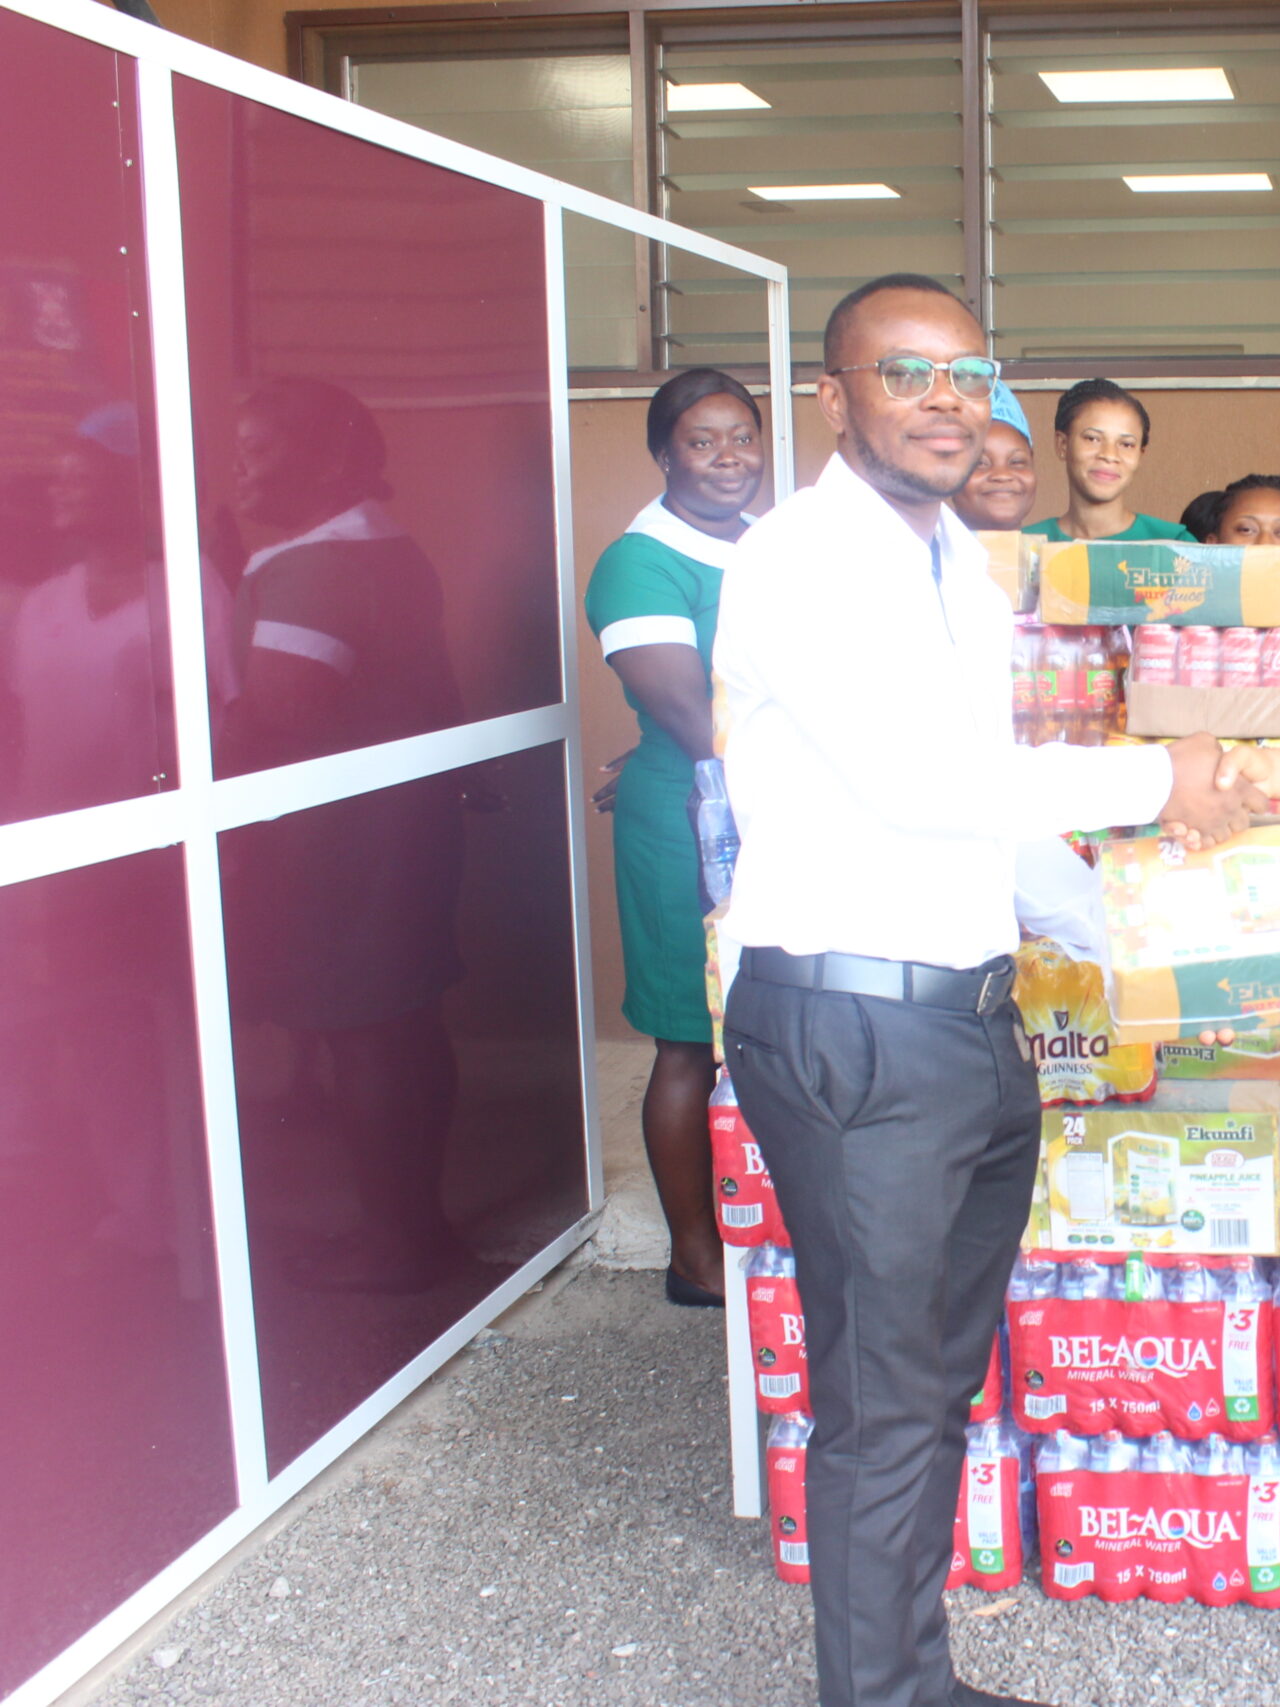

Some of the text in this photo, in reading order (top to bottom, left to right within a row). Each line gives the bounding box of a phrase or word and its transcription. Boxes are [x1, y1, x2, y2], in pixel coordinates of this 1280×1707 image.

[1037, 1061, 1093, 1076] GUINNESS
[1062, 1116, 1085, 1136] 24
[1186, 1126, 1253, 1141] Ekumfi
[1227, 1309, 1255, 1331] +3
[1228, 1341, 1251, 1351] FREE
[1067, 1369, 1155, 1383] MINERAL WATER
[1090, 1399, 1105, 1413] 15
[1121, 1398, 1161, 1414] 750ml
[971, 1463, 996, 1485] +3
[972, 1494, 993, 1504] FREE
[1252, 1482, 1279, 1503] +3
[1253, 1511, 1274, 1521] FREE
[1095, 1539, 1182, 1553] MINERAL WATER
[1116, 1569, 1131, 1584] 15
[1148, 1568, 1187, 1585] 750ml
